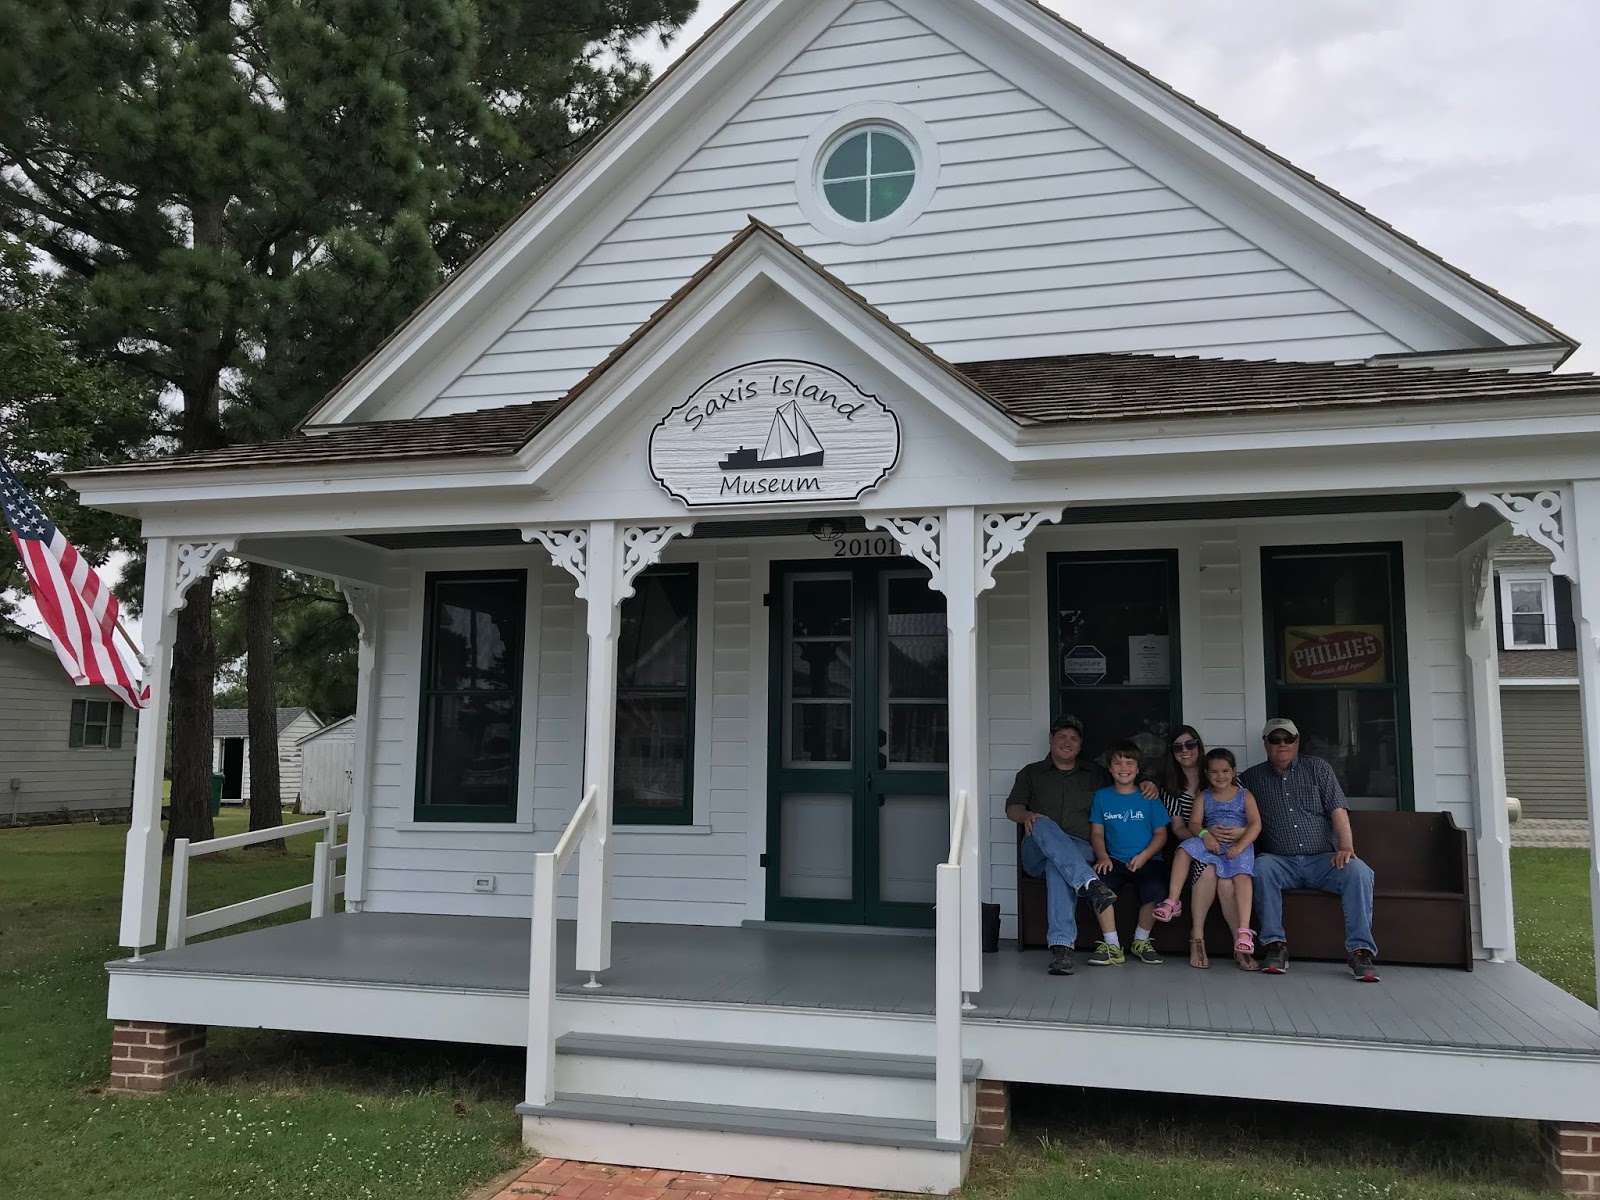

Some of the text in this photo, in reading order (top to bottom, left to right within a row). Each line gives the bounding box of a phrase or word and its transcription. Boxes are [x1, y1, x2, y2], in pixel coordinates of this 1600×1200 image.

[684, 374, 865, 431] Saxis Island
[719, 475, 820, 495] Museum
[834, 537, 897, 557] 20101
[1293, 635, 1377, 669] PHILLIES
[1130, 810, 1145, 819] Life
